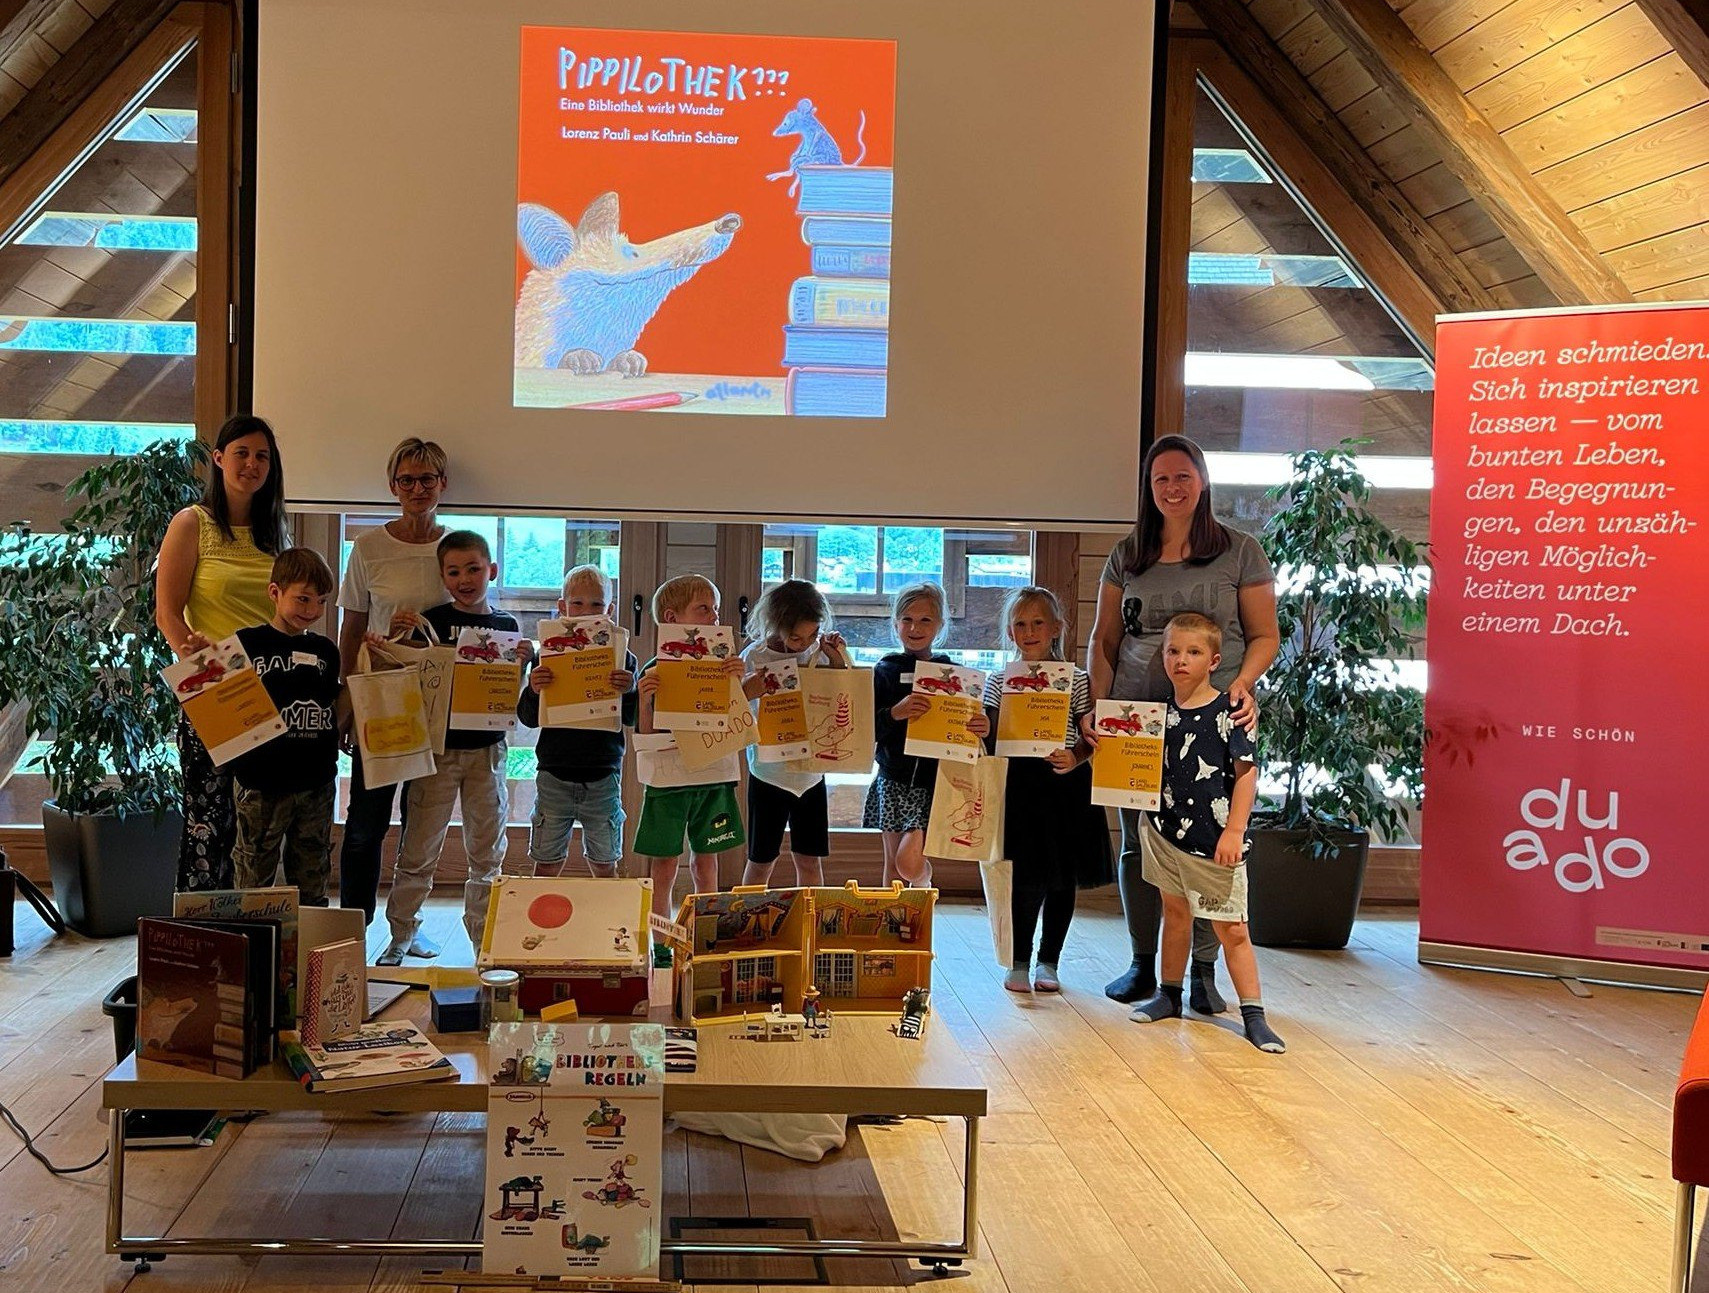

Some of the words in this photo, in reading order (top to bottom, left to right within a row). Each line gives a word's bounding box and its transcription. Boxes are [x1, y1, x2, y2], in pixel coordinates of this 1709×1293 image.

[560, 98, 586, 112] Eine
[588, 99, 644, 114] Bibliothek
[647, 102, 676, 115] wirkt
[678, 102, 725, 117] Wunder
[561, 127, 599, 140] Lorenz
[602, 128, 632, 141] Pauli
[633, 133, 649, 142] und
[651, 130, 693, 144] Kathrin
[695, 131, 739, 145] Schärer
[1469, 345, 1546, 369] Ideen
[1469, 376, 1526, 402] Sich
[1538, 375, 1699, 404] inspirieren
[1469, 411, 1557, 435] lassen
[1607, 413, 1664, 431] vom
[1467, 445, 1563, 467] bunten
[1573, 442, 1666, 467] Leben,
[1466, 477, 1515, 500] den
[1525, 477, 1676, 505] Begegnun-
[1464, 515, 1521, 538] gen,
[1535, 510, 1586, 533] den
[1598, 510, 1697, 534] unzäh-
[1464, 543, 1530, 572] ligen
[1540, 544, 1656, 573] Möglich-
[1463, 577, 1546, 600] keiten
[1557, 581, 1637, 602] unter
[1462, 611, 1541, 634] einem
[1551, 612, 1630, 637] Dach.
[1522, 725, 1556, 738] WIE
[1572, 727, 1635, 743] SCHÖN
[585, 1071, 647, 1086] REGELN
